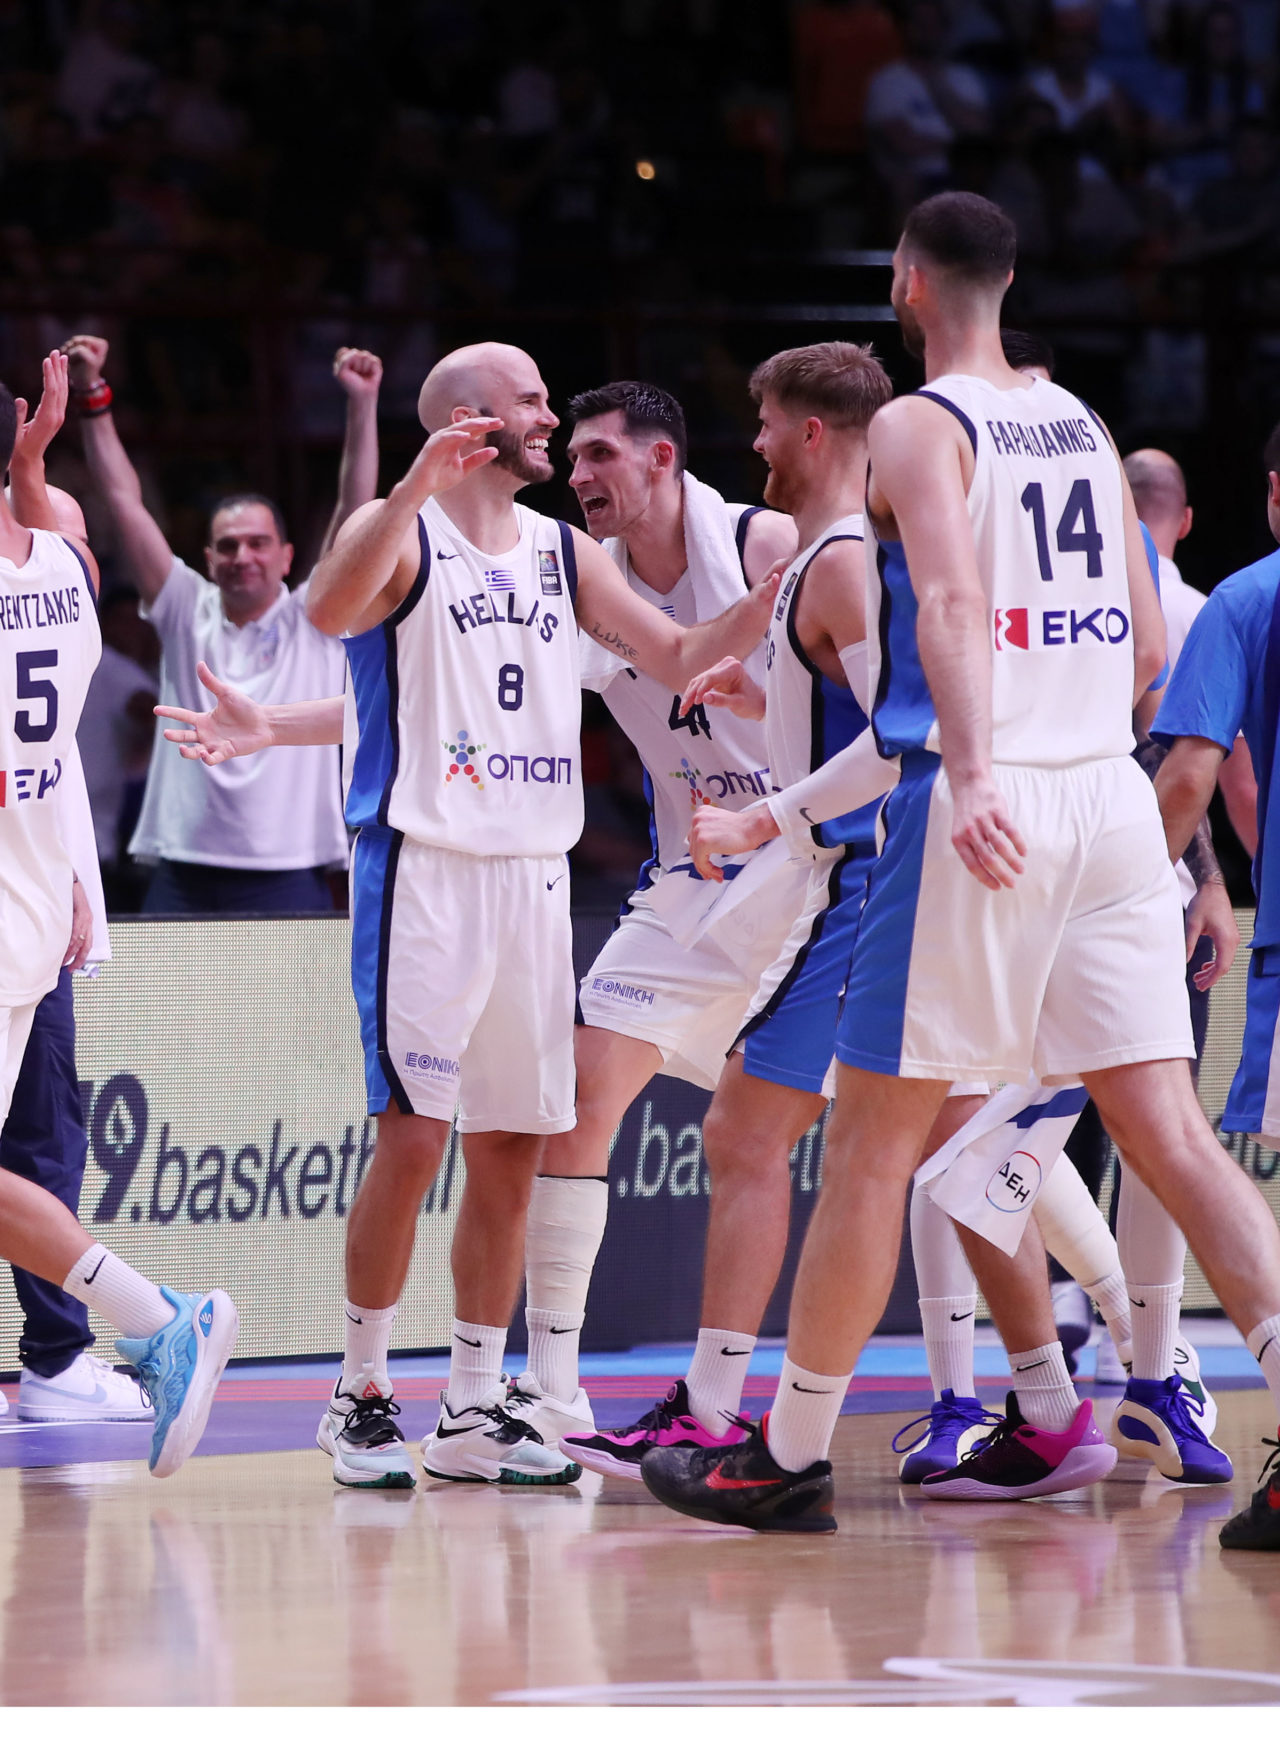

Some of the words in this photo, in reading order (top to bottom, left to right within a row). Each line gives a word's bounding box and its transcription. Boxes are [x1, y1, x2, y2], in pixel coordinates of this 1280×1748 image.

[1021, 479, 1104, 582] 14
[449, 592, 560, 643] HELLAS
[593, 622, 639, 661] LUKE
[1043, 607, 1130, 645] EKO
[14, 649, 58, 743] 5
[498, 664, 524, 712] 8
[998, 1161, 1031, 1204] ΔΕΗ
